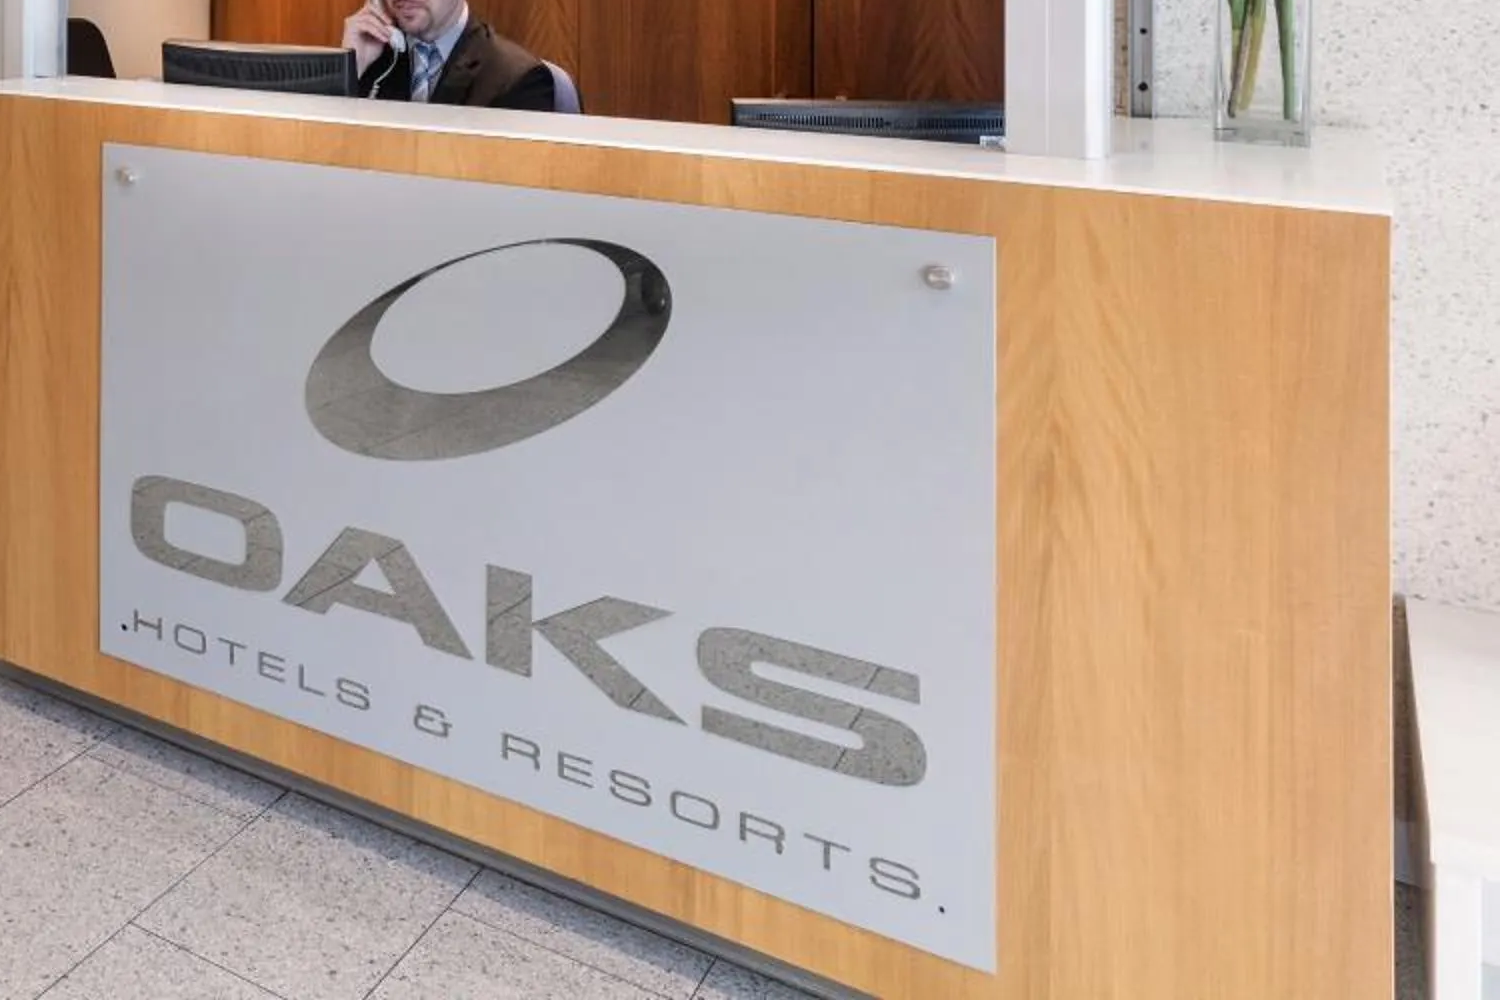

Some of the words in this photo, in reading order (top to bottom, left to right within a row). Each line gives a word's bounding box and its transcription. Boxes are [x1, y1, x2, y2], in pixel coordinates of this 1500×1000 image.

[128, 474, 928, 788] OAKS
[130, 607, 371, 712] HOTELS
[412, 703, 454, 739] &
[500, 732, 923, 901] RESORTS
